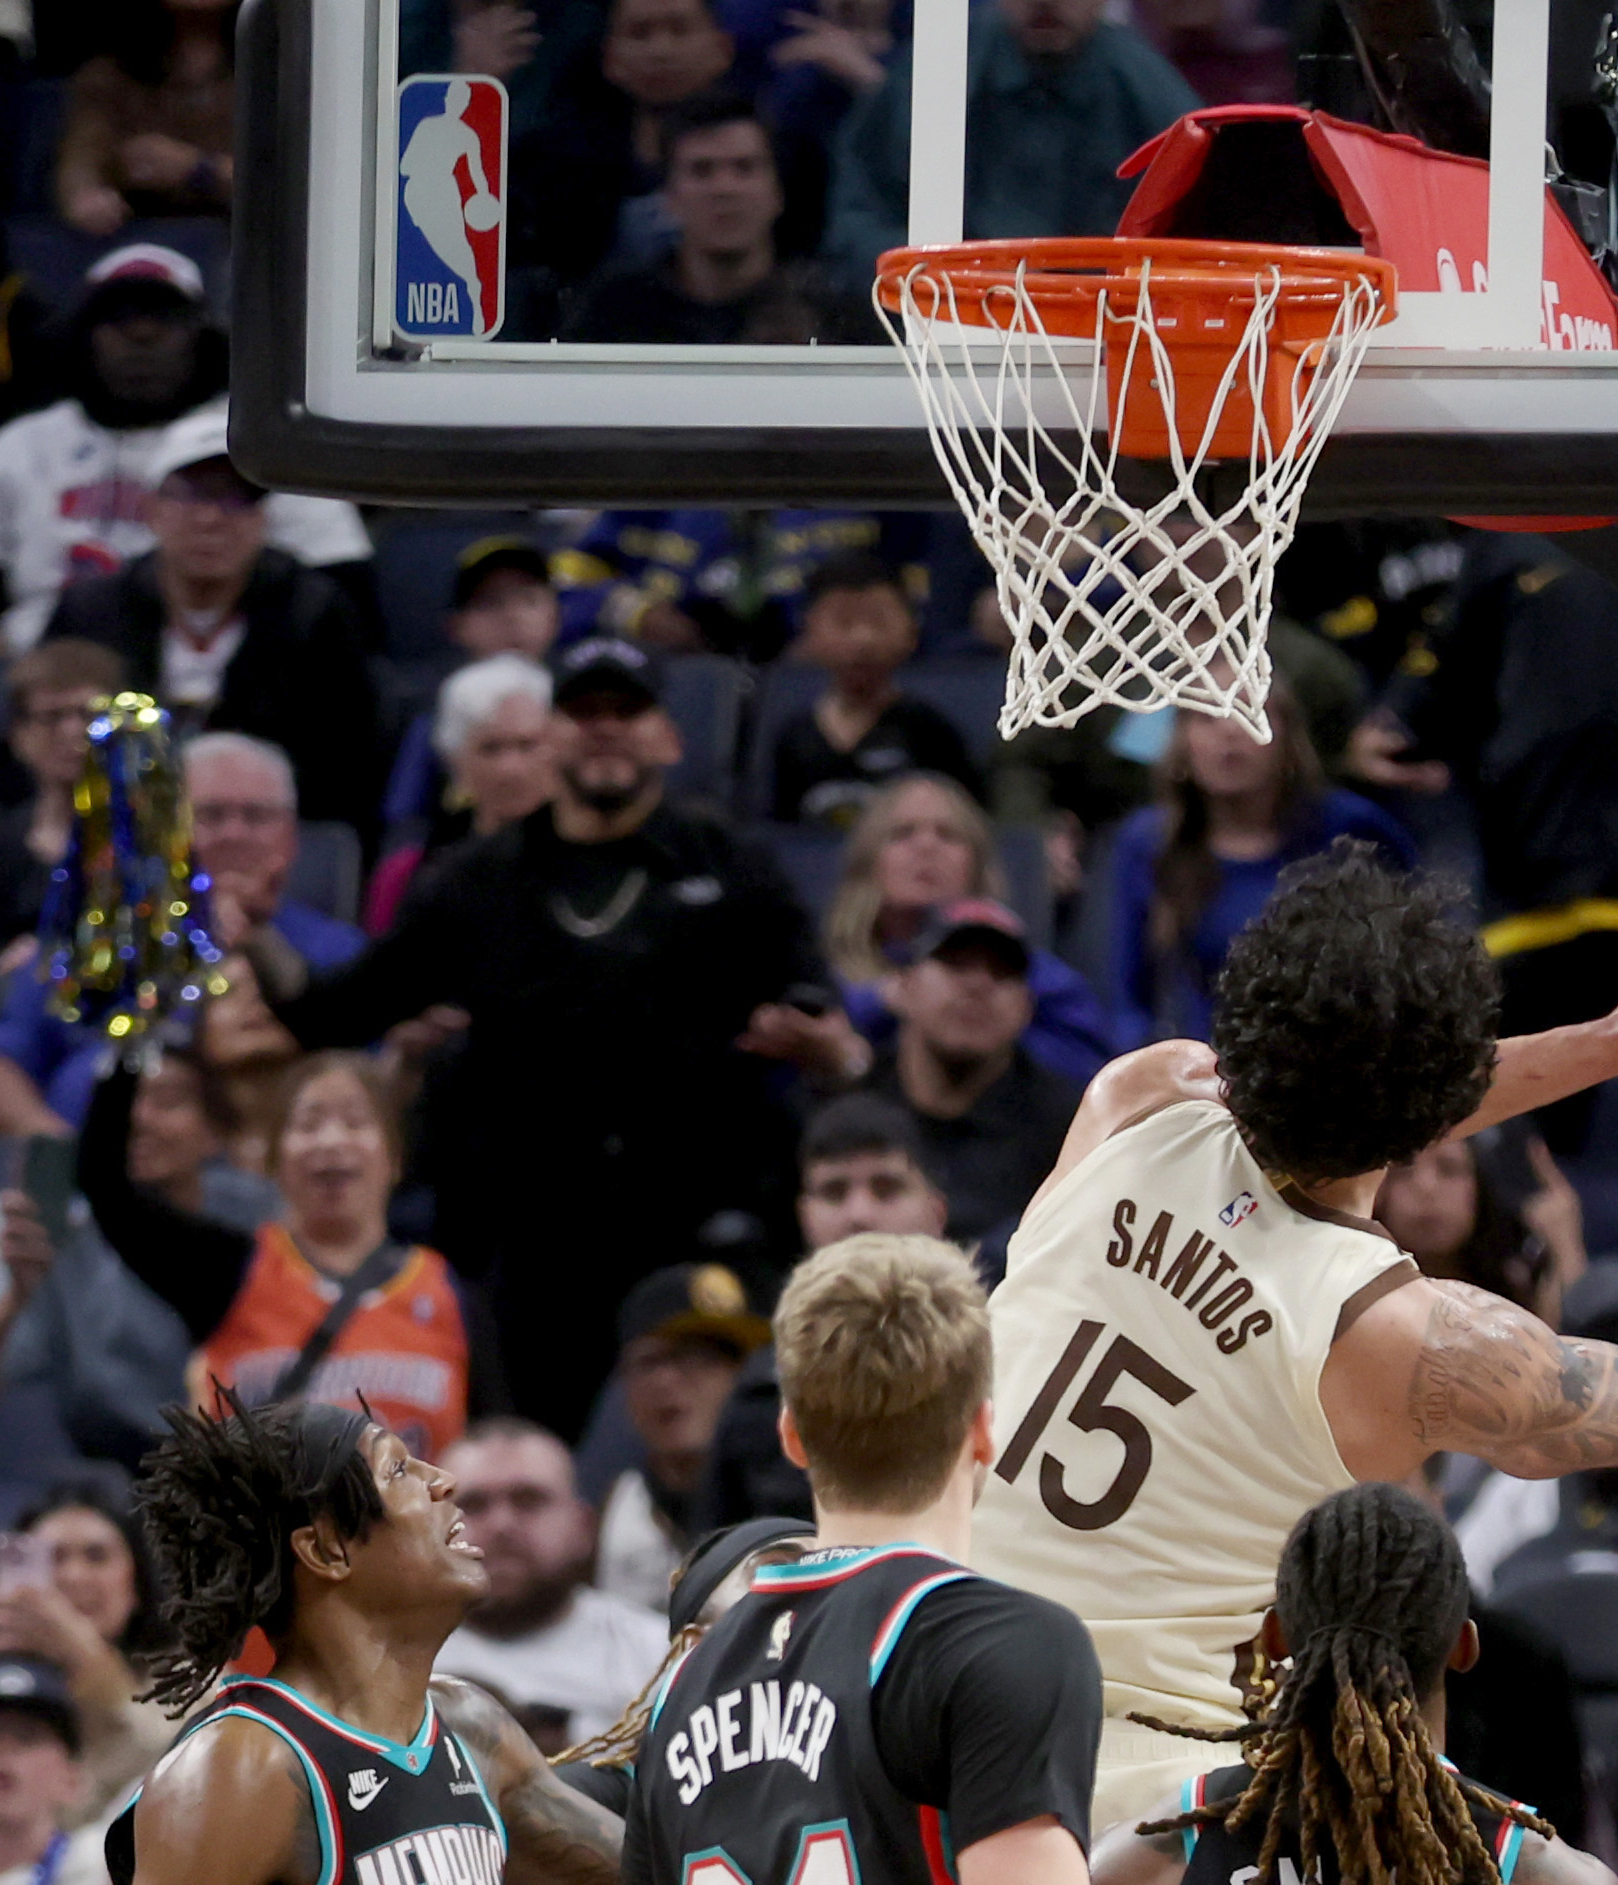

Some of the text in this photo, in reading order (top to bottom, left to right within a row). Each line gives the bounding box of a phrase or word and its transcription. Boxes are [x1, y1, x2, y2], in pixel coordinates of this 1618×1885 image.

[407, 282, 460, 324] NBA
[1106, 1198, 1273, 1355] SANTOS
[993, 1318, 1197, 1531] 15
[348, 1769, 379, 1797] NIKE
[666, 1679, 836, 1806] SPENCER
